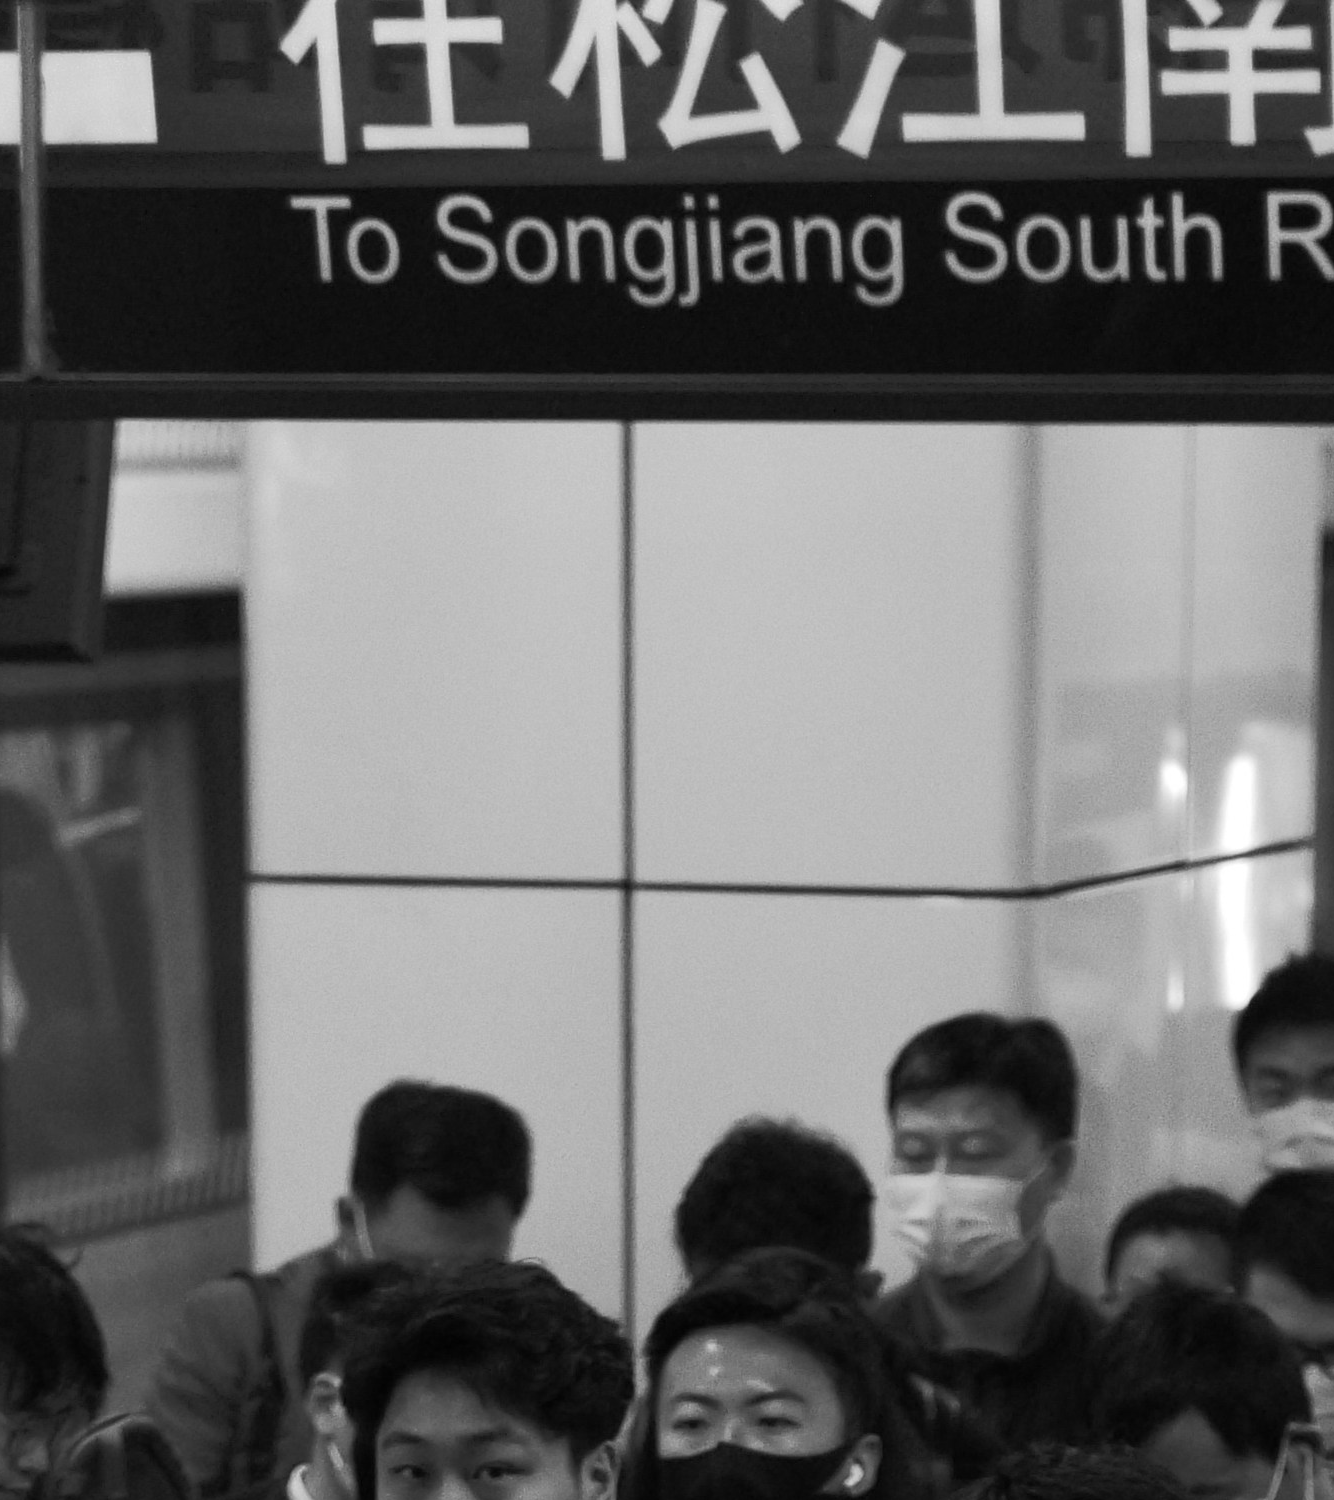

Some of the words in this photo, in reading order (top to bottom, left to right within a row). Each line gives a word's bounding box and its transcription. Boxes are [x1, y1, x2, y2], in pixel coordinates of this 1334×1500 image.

[289, 195, 400, 284] To
[436, 193, 904, 307] Songjiang
[944, 190, 1224, 283] South
